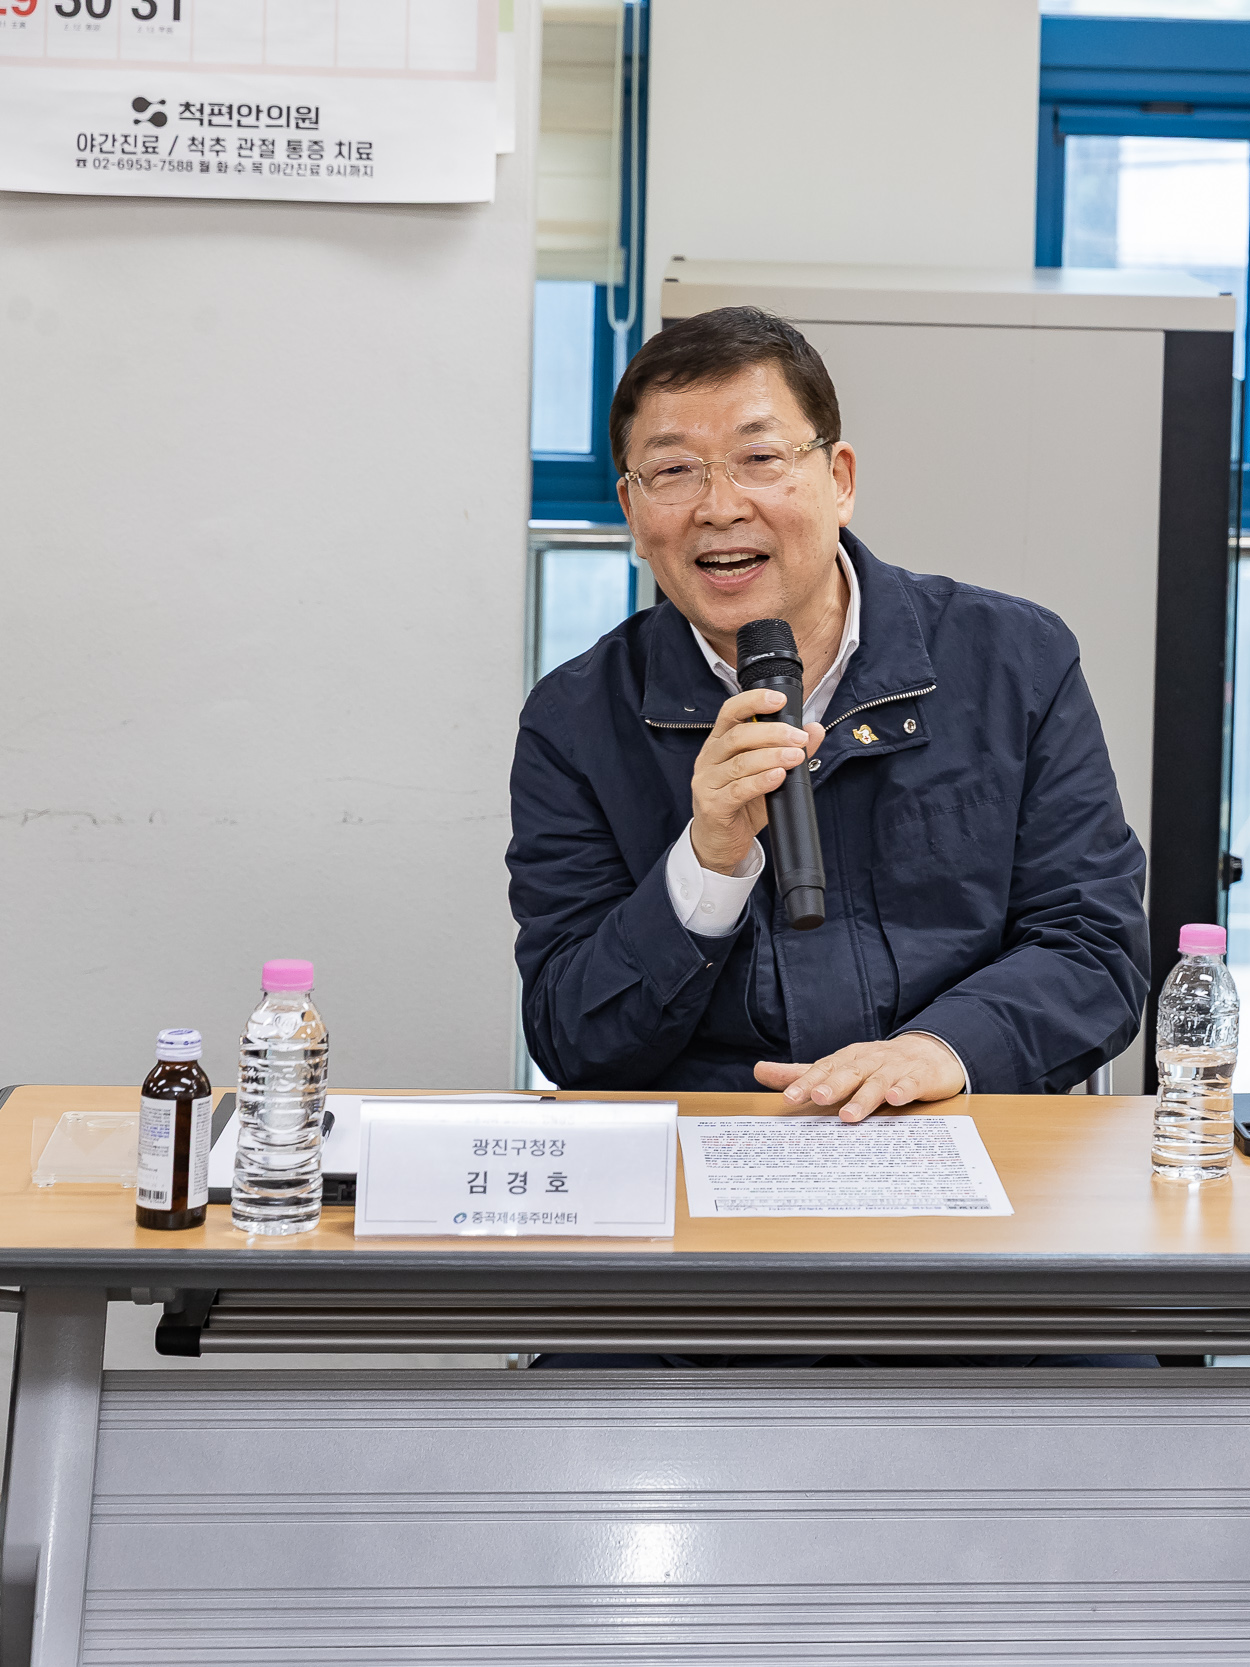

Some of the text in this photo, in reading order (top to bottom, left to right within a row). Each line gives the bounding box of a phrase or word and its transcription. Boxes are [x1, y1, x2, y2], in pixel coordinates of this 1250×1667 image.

[178, 101, 320, 131] 척편안의원
[76, 132, 160, 156] 야간진료
[187, 135, 227, 157] 척추
[236, 137, 276, 160] 관절
[285, 139, 325, 161] 통증
[334, 140, 373, 161] 치료
[92, 157, 374, 177] 02-6953-7588 월 화 수 목 야간진료 9시까지
[472, 1138, 566, 1158] 광진구청장
[471, 1211, 578, 1225] 중곡제4동주민센터
